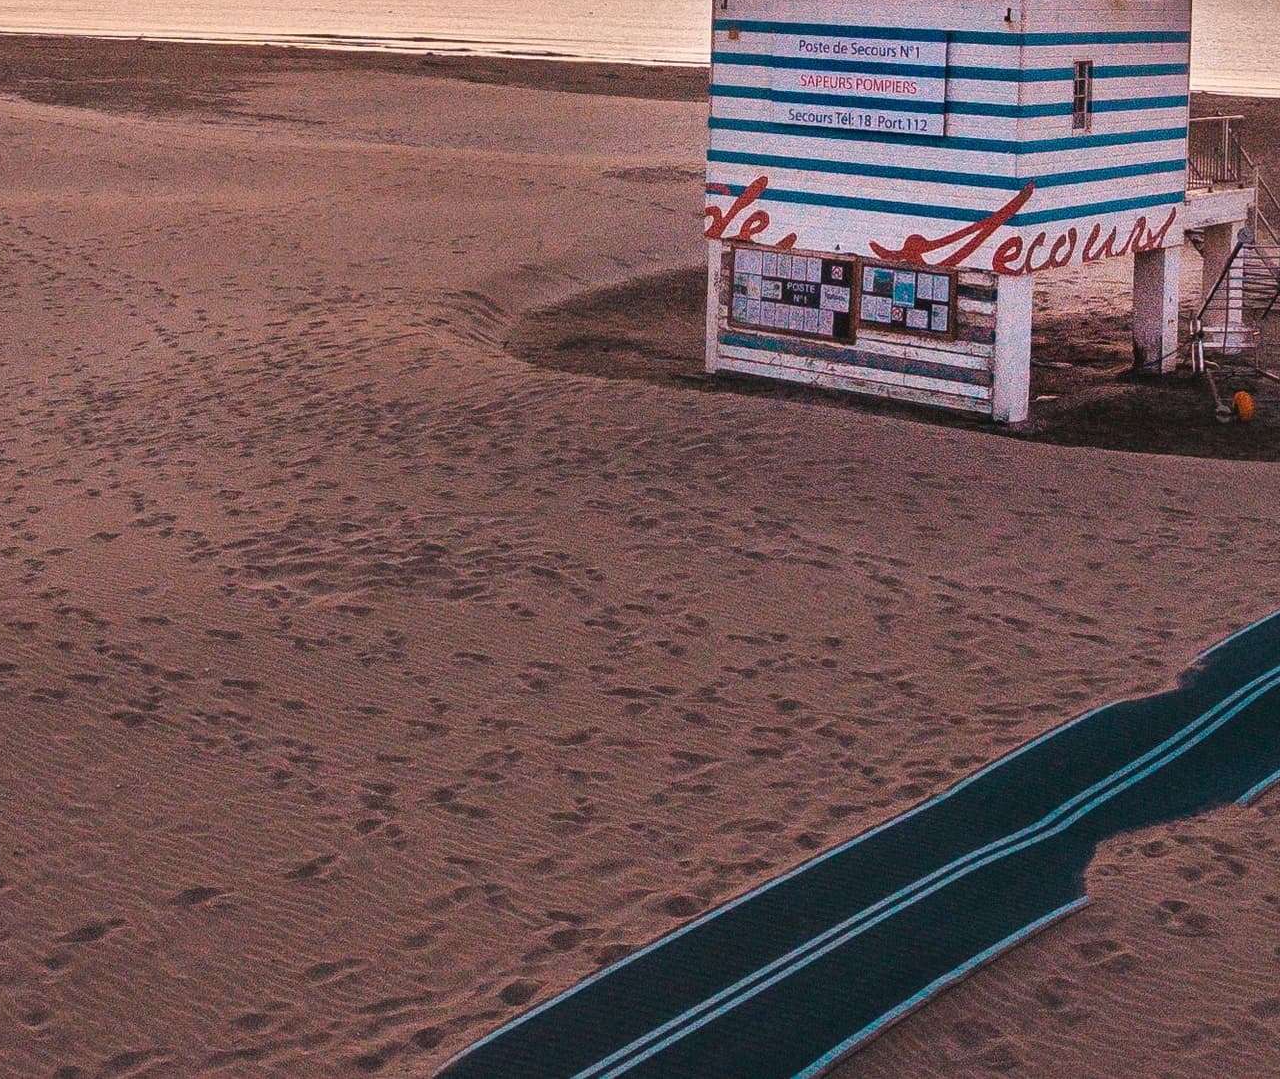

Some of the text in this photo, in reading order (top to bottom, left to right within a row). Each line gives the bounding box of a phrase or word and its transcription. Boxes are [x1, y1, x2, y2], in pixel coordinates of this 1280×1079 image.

[798, 39, 830, 54] Poste
[833, 42, 848, 55] de
[851, 43, 897, 58] Secours
[800, 74, 917, 95] SAPEURS POMPIERS
[788, 109, 833, 124] Secours
[858, 114, 871, 127] 18
[869, 182, 1178, 276] Secours
[786, 282, 816, 293] POSTE
